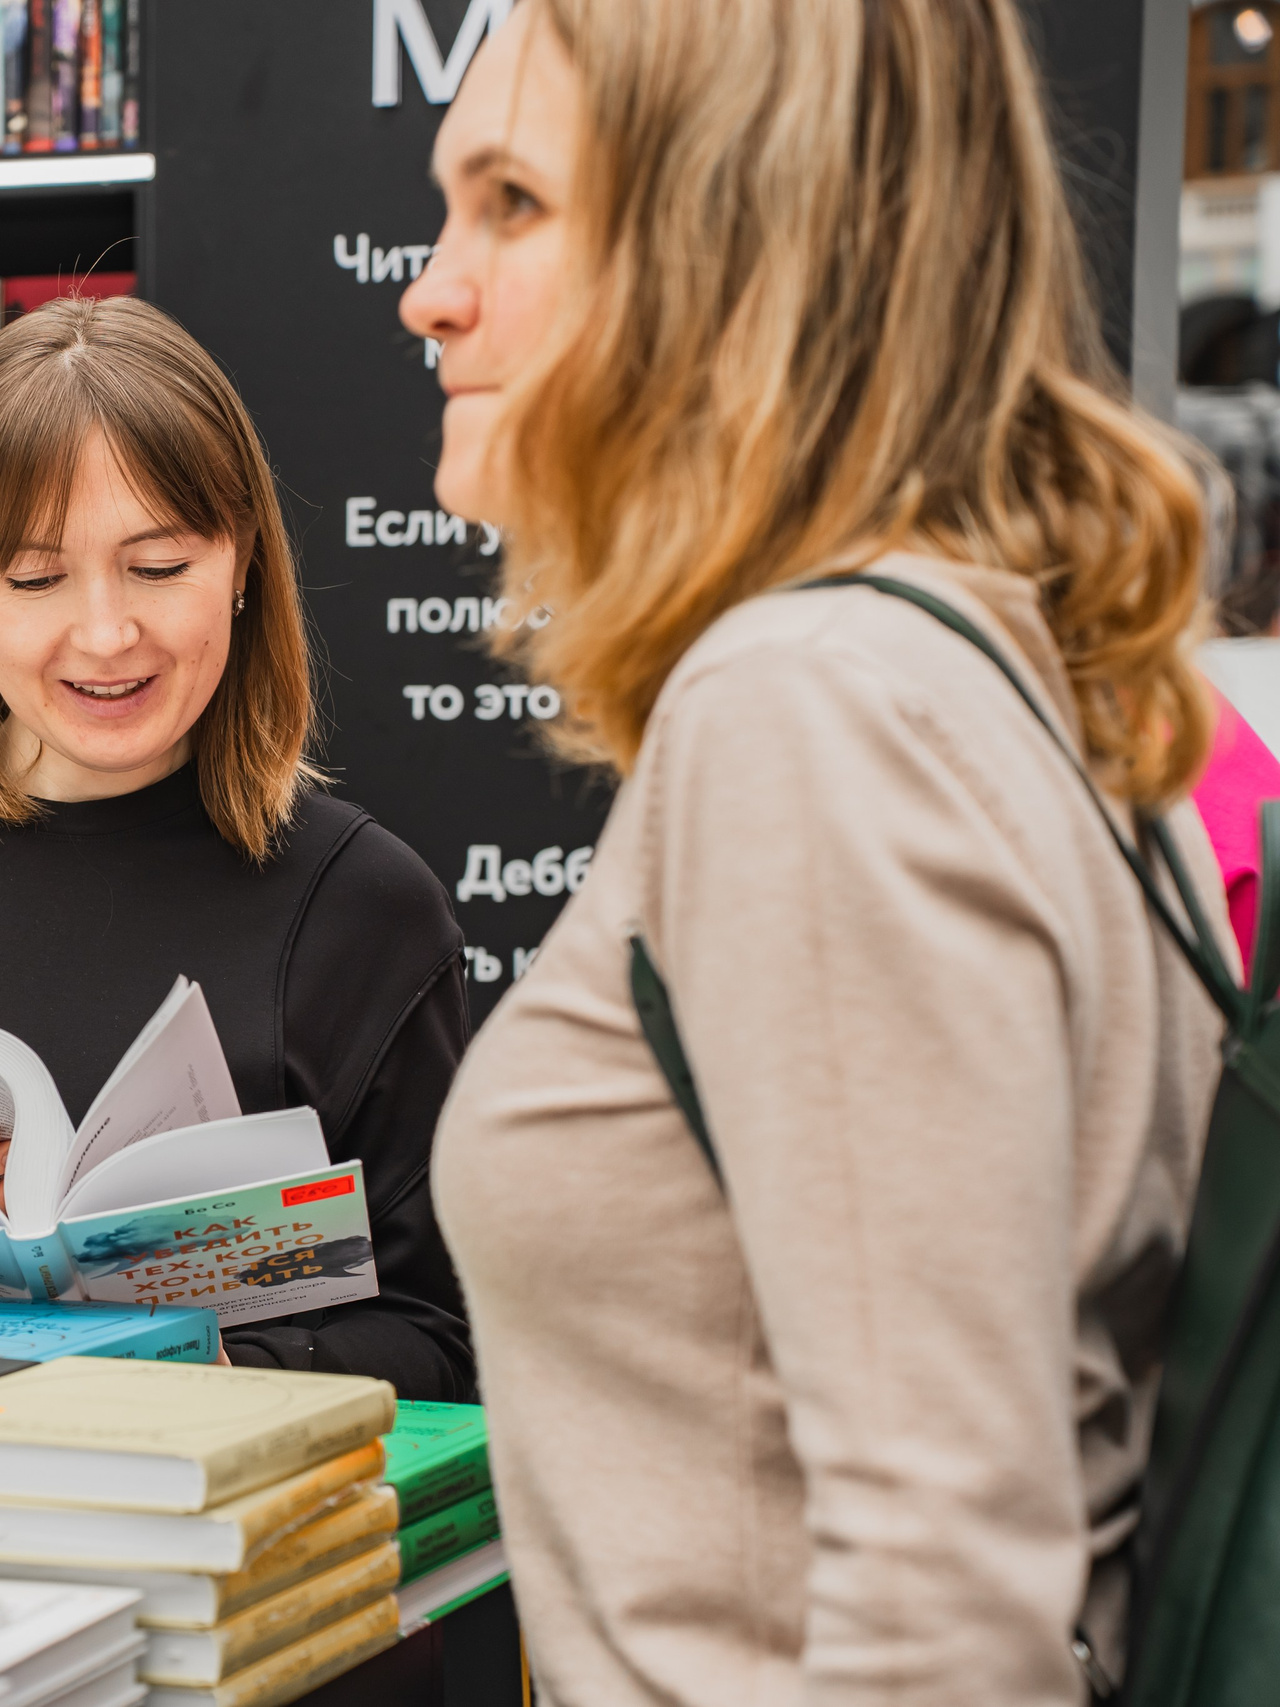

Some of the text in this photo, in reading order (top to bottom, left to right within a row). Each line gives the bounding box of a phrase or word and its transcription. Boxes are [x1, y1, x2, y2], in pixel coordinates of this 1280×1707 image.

[346, 496, 467, 546] Если
[402, 684, 560, 721] то это
[173, 1215, 258, 1240] КАК
[184, 1201, 236, 1216] Бо Со
[118, 1234, 325, 1280] ТЕХ, КОГО
[123, 1222, 314, 1264] УБЕДИТЬ
[133, 1249, 316, 1293] ХОЧЕТСЯ
[135, 1265, 324, 1304] ПРИБИТЬ
[290, 1281, 326, 1293] спора
[249, 1295, 307, 1310] личности
